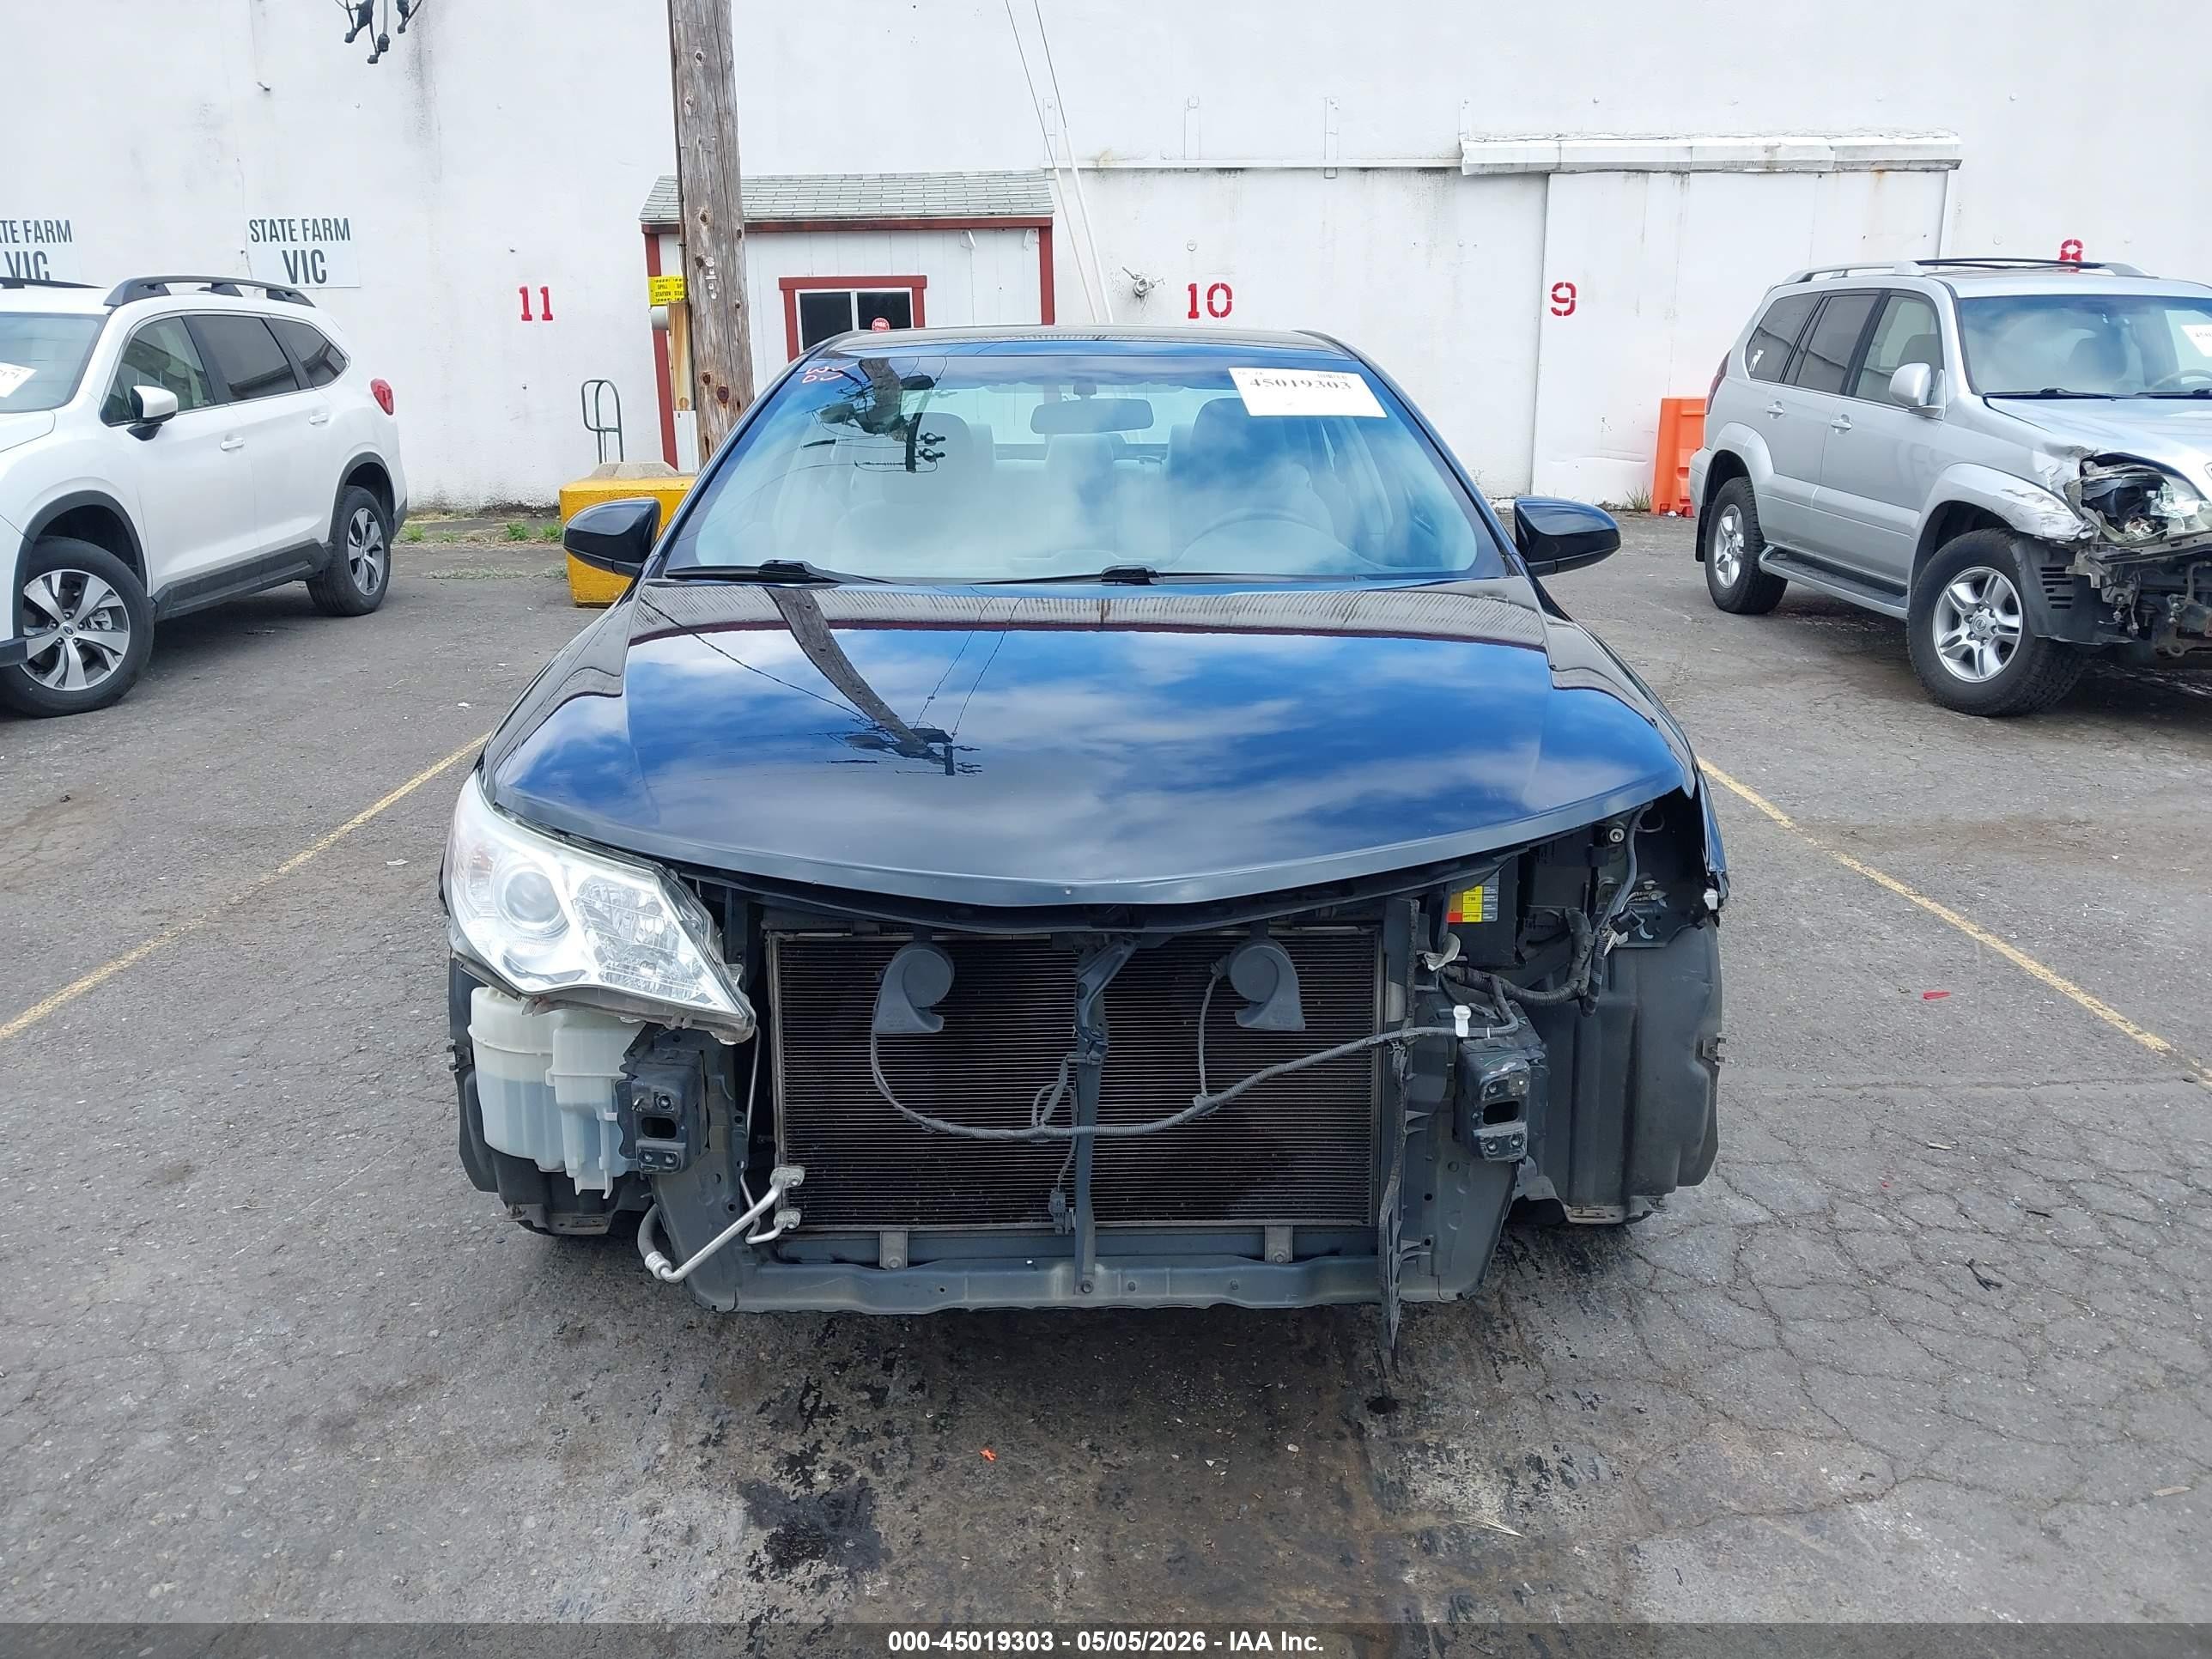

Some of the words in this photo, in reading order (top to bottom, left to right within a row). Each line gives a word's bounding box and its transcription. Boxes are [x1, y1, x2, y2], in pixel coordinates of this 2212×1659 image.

[22, 219, 73, 244] FARM
[249, 218, 298, 243] STATE
[301, 217, 351, 242] FARM
[3, 250, 51, 281] VIC
[281, 248, 327, 285] VIC
[519, 286, 554, 321] 11
[1188, 283, 1233, 319] 10
[1551, 282, 1577, 317] 9
[1249, 378, 1352, 391] 45019303
